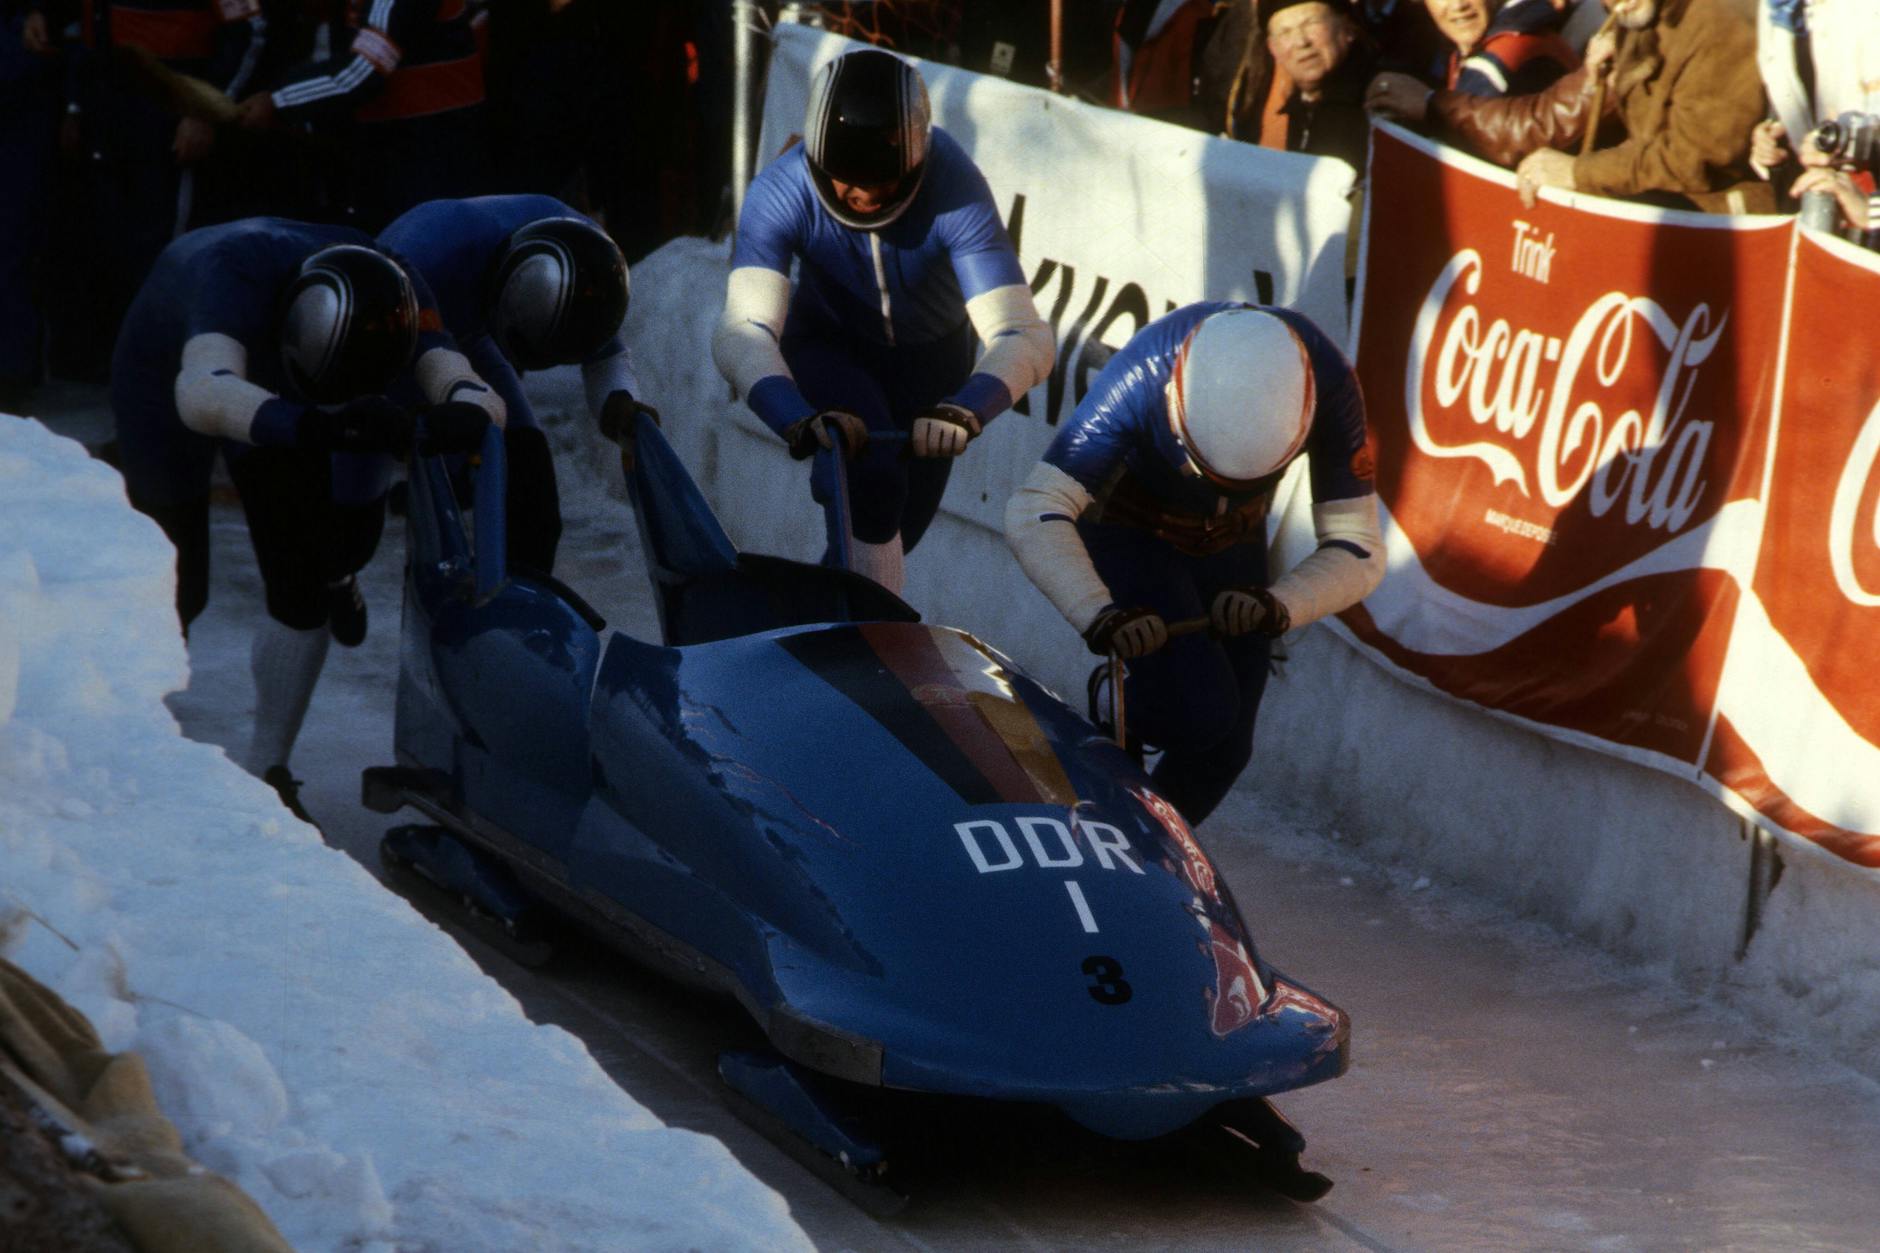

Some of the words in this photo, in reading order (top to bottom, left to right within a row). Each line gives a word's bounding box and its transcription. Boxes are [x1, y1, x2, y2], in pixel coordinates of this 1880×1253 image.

[1512, 220, 1556, 284] Trink
[1405, 249, 1729, 532] Coca-Cola
[953, 816, 1146, 874] DDR
[1082, 956, 1132, 1005] 3
